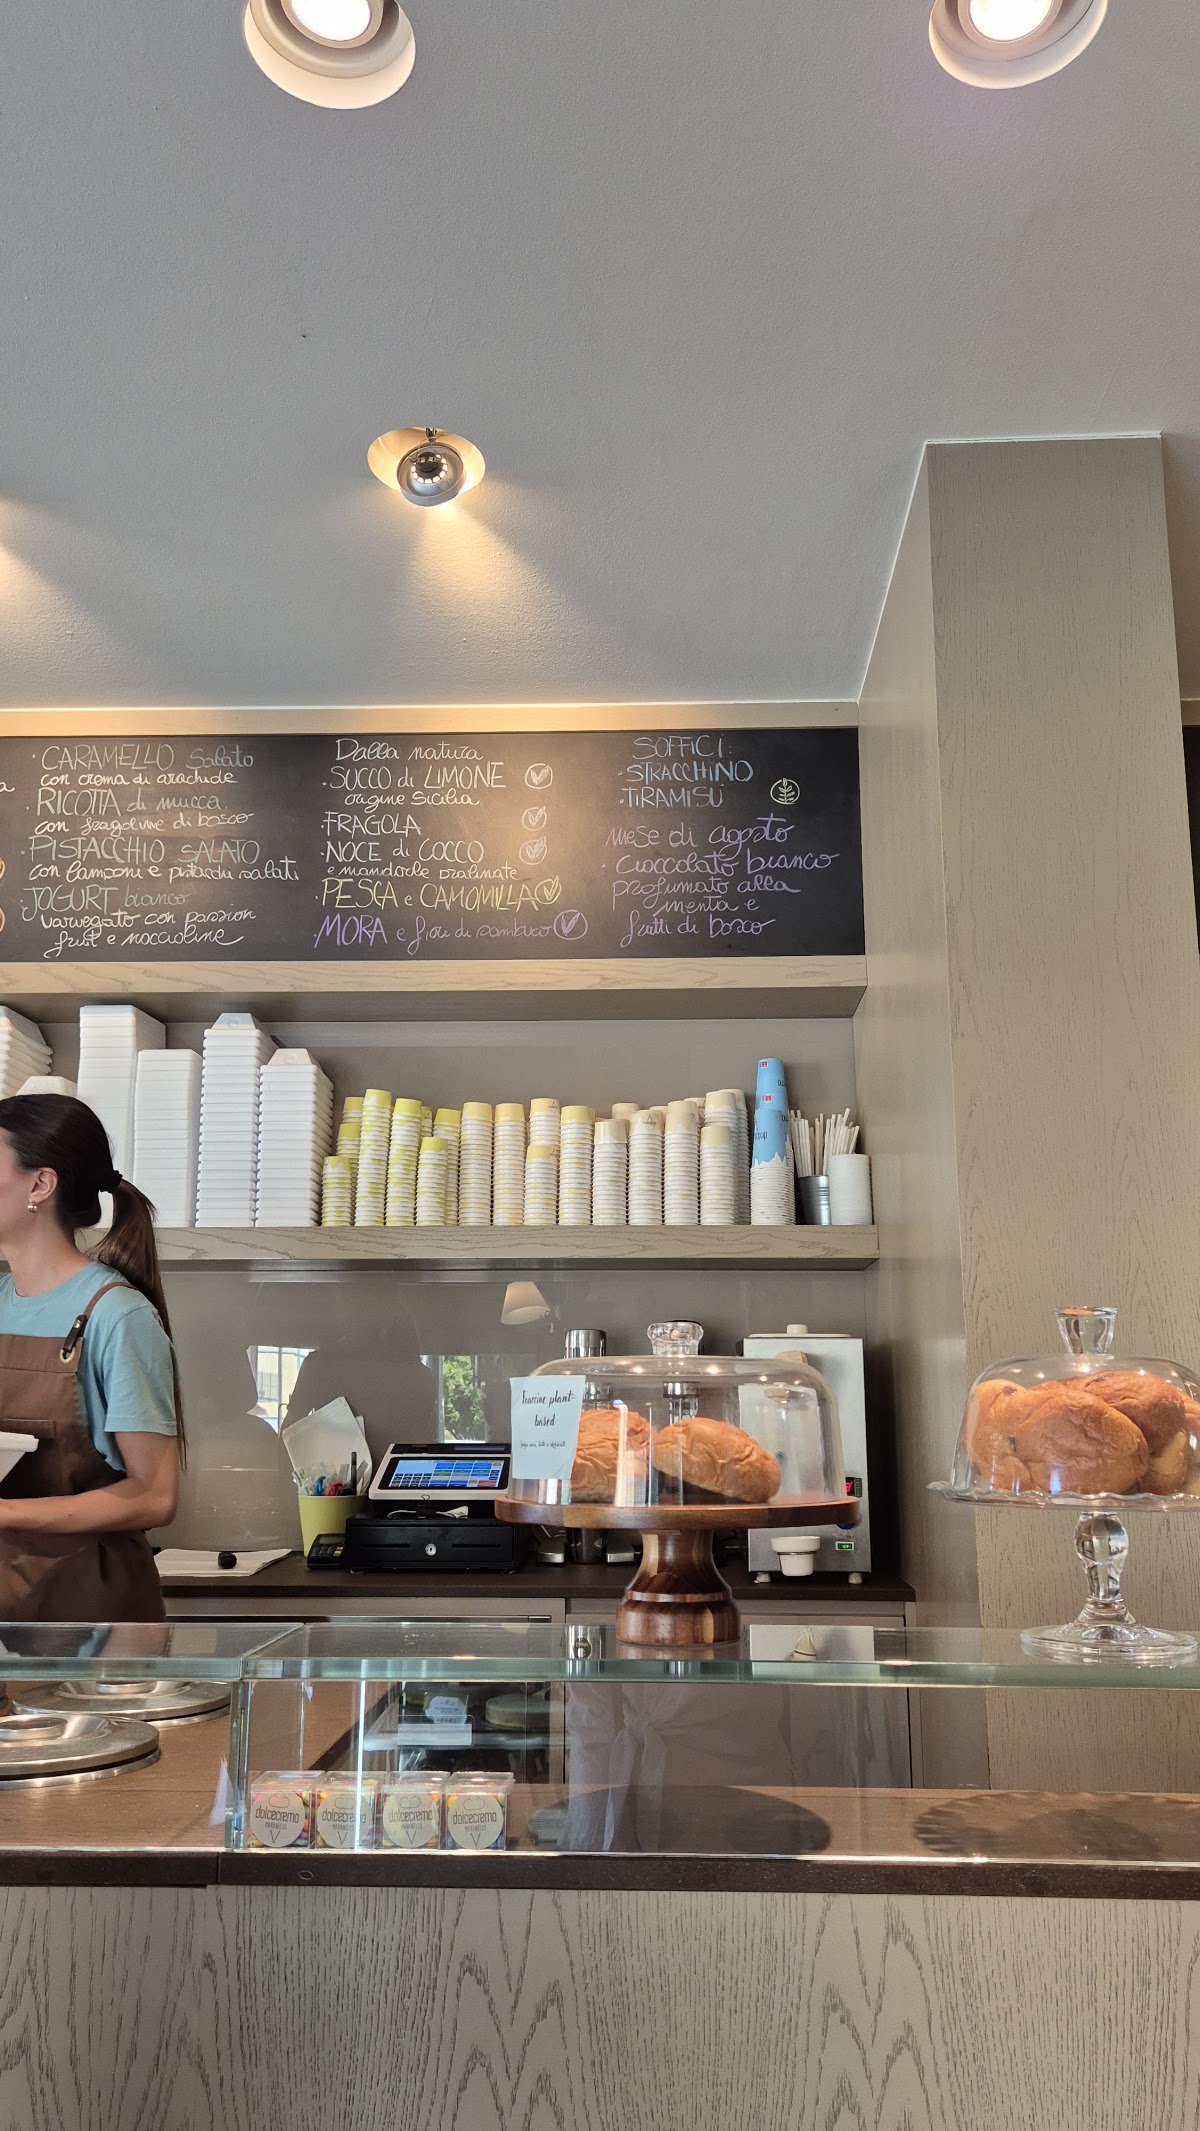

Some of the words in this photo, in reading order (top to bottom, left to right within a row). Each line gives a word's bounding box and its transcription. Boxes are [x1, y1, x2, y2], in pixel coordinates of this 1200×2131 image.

[42, 744, 174, 770] CARAMELLO
[336, 738, 399, 761] Dalla
[408, 741, 484, 760] natura
[40, 774, 70, 786] con
[78, 774, 130, 786] crema
[133, 772, 151, 785] di
[157, 770, 238, 784] arachide
[330, 766, 391, 790] SUCCO
[398, 767, 414, 787] di
[424, 762, 506, 789] LIMONE
[37, 787, 121, 816] RICOTTA
[127, 788, 147, 812] di
[345, 794, 405, 813] origine
[411, 788, 480, 805] Sicilia
[35, 821, 69, 836] con
[80, 817, 166, 837] fragoline
[173, 812, 191, 829] di
[198, 812, 255, 827] bosco
[323, 811, 421, 838] FRAGOLA
[669, 822, 698, 847] di
[709, 813, 795, 861] agosto
[28, 835, 165, 864] PISTACCHIO
[178, 839, 260, 864] SALATO
[326, 841, 382, 863] NOCE
[393, 839, 411, 857] di
[419, 839, 484, 863] COCCO
[747, 848, 840, 874] bianco
[29, 864, 60, 880] con
[66, 860, 143, 882] lamponi
[147, 866, 162, 877] e
[169, 863, 235, 883] pistacchi
[239, 856, 299, 880] salati
[328, 867, 335, 875] e
[338, 861, 429, 878] mandorle
[440, 861, 519, 879] pralinate
[22, 884, 119, 921] JOGURT
[125, 885, 192, 907] bianco
[321, 878, 398, 910] PESCA
[405, 895, 413, 906] e
[420, 883, 539, 912] CAMOMILLA
[612, 874, 729, 911] profumato
[737, 875, 801, 893] alla
[653, 895, 739, 917] menta
[744, 898, 760, 911] e
[40, 908, 141, 940] variegato
[144, 912, 176, 925] con
[185, 904, 256, 930] passion
[314, 914, 387, 948] MORA
[397, 928, 407, 941] e
[407, 916, 450, 955] fiori
[455, 917, 471, 938] di
[476, 918, 552, 938] sambuco
[620, 910, 672, 947] frutti
[677, 915, 699, 934] di
[709, 914, 776, 938] bosco
[43, 929, 98, 958] fruit
[107, 935, 116, 945] e
[121, 924, 244, 946] noccioline
[255, 1806, 300, 1824] dolcecrema
[322, 1808, 367, 1824] dolcecrea
[452, 1810, 498, 1825] dolcecrema
